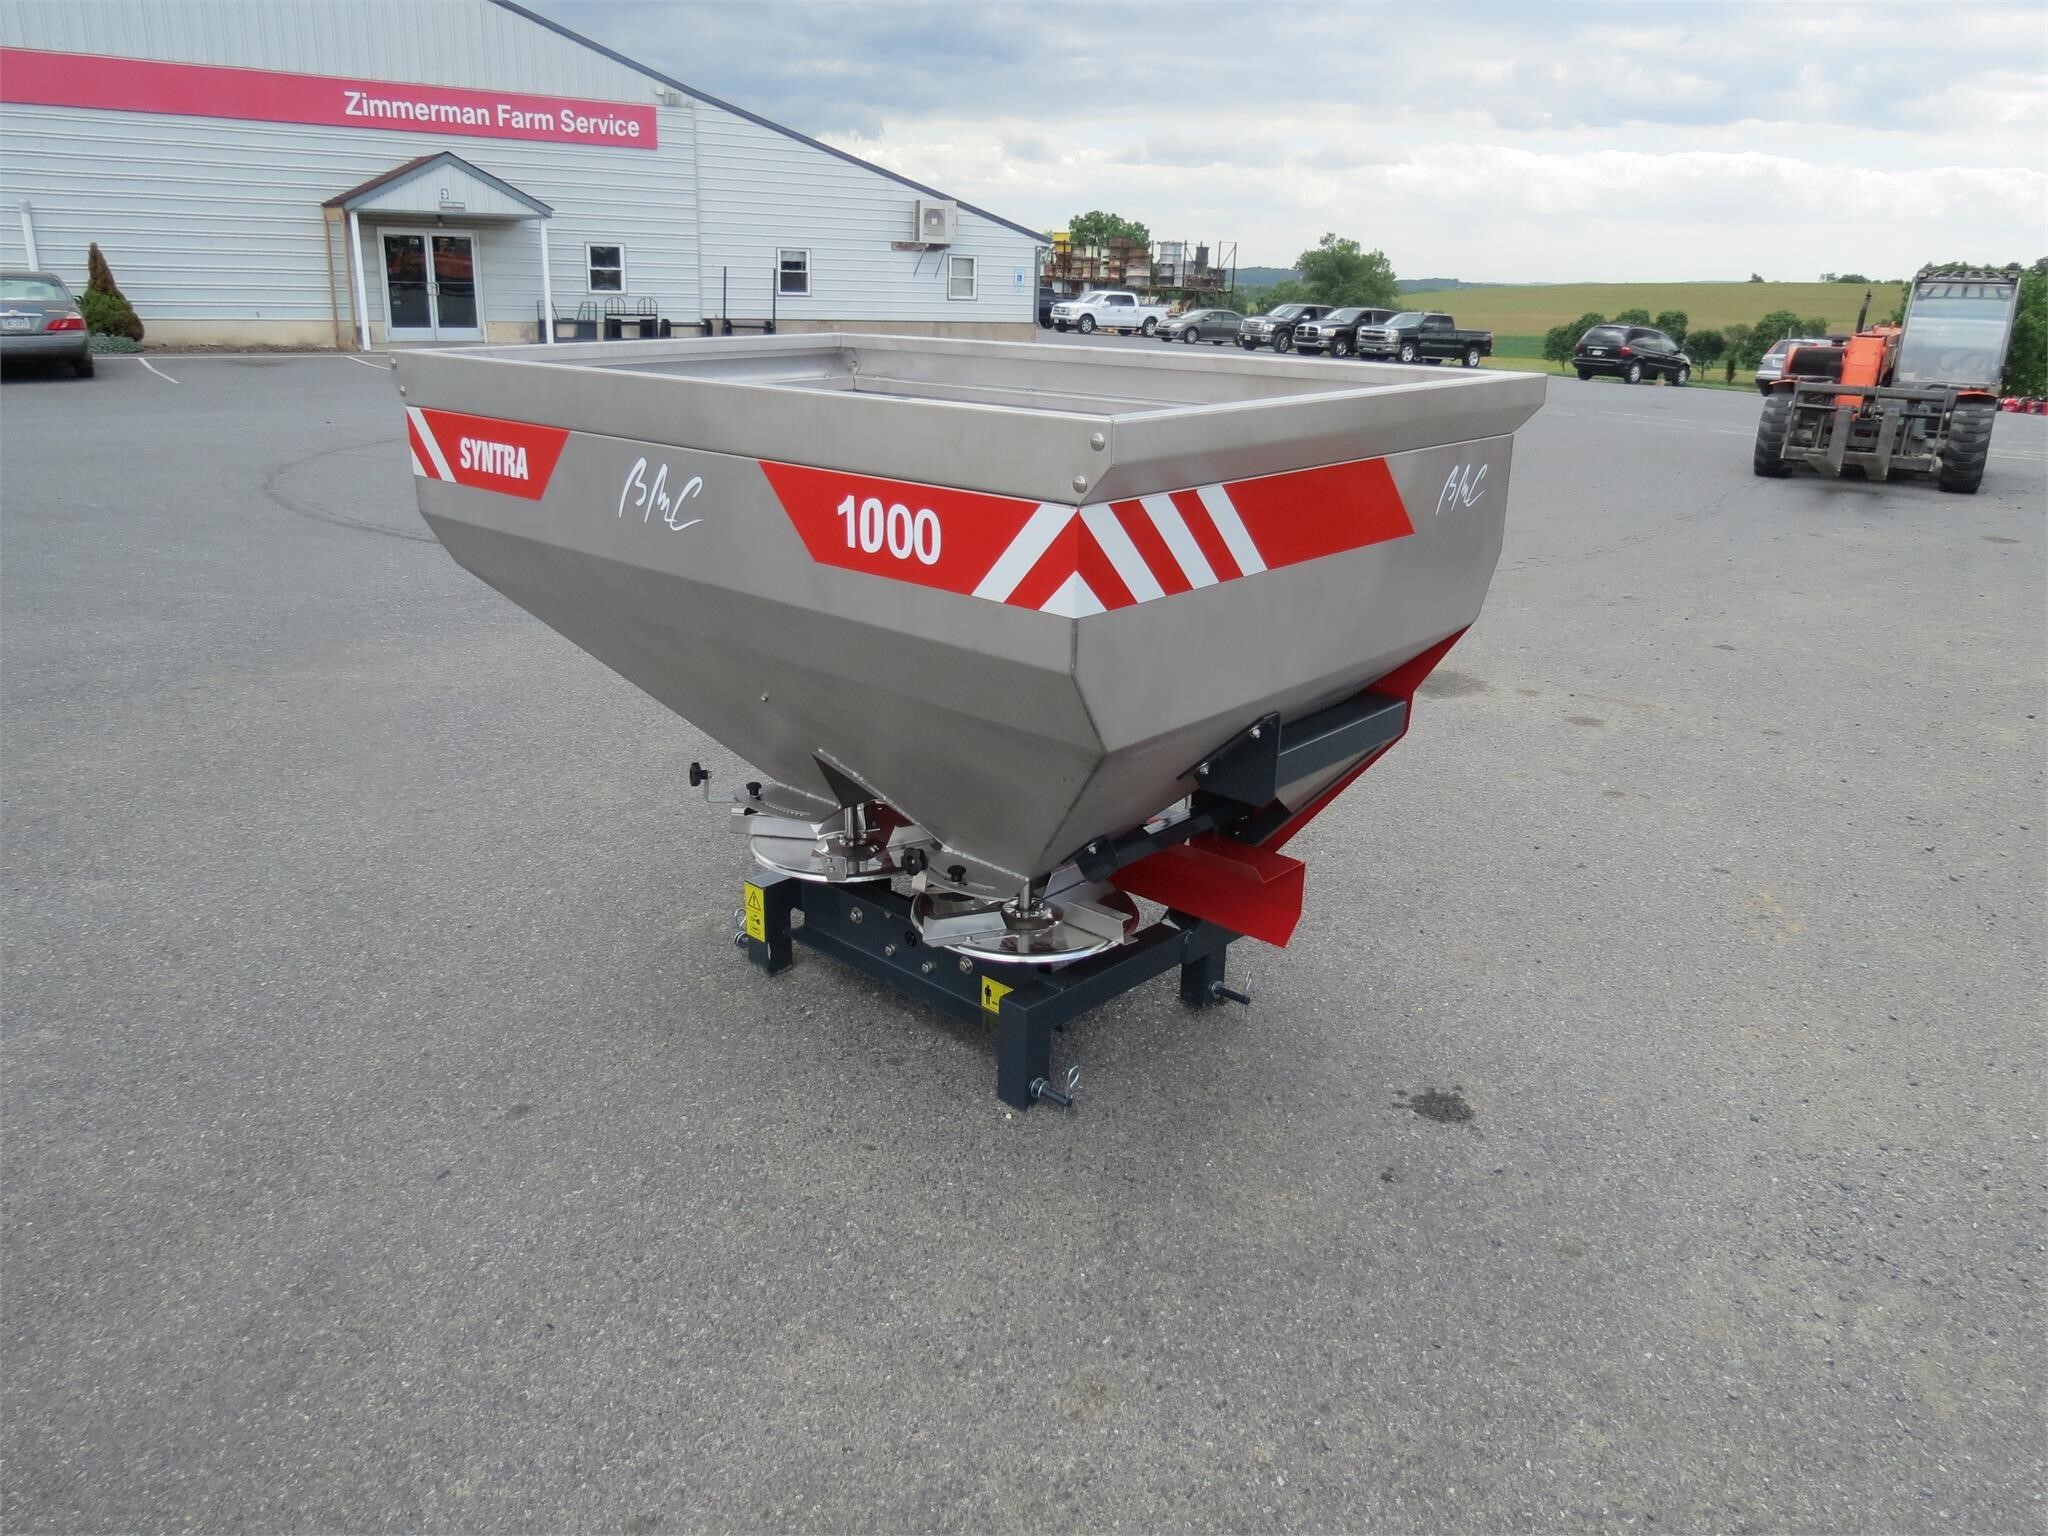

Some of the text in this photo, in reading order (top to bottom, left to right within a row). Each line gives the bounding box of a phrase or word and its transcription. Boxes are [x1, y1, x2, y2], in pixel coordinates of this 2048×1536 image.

[343, 91, 641, 138] Zimmerman Farm Service
[460, 437, 529, 481] SYNTRA
[837, 494, 942, 566] 1000
